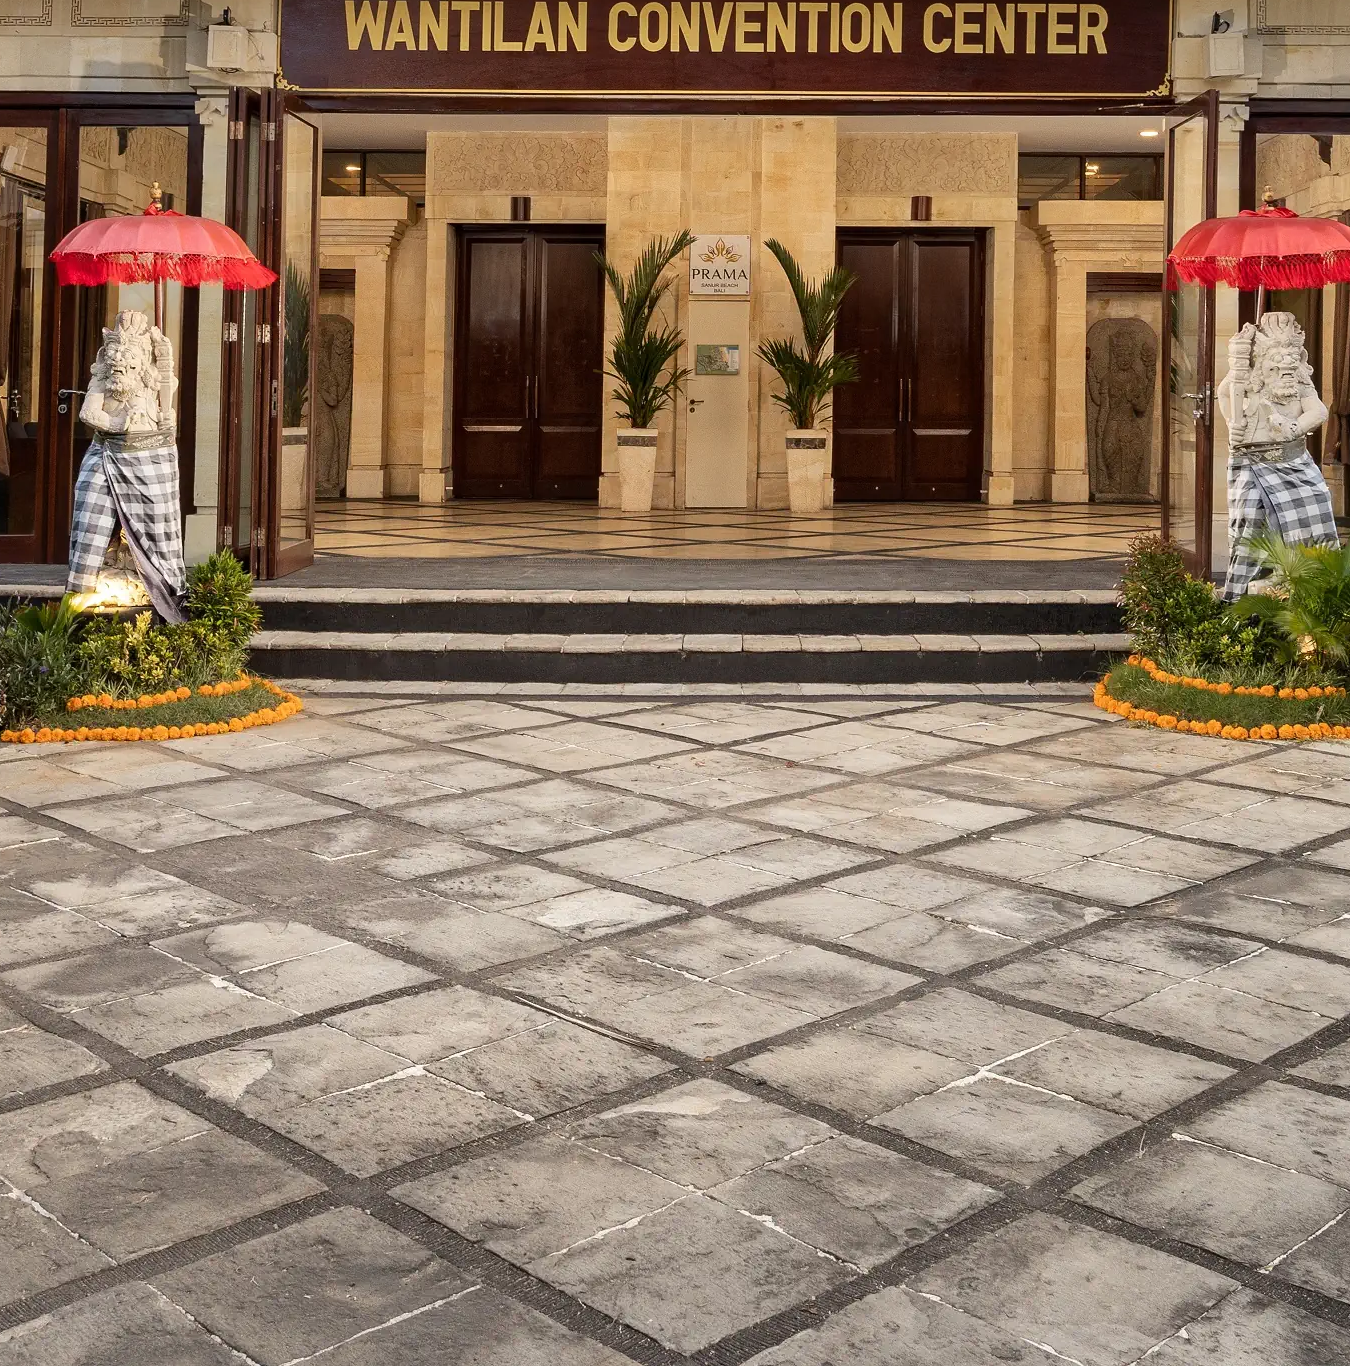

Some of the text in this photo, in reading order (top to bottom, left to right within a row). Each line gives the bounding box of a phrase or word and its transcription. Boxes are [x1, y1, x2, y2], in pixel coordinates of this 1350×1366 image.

[345, 1, 1109, 55] WANTILAN CONVENTION CENTER
[692, 268, 748, 280] PRAMA
